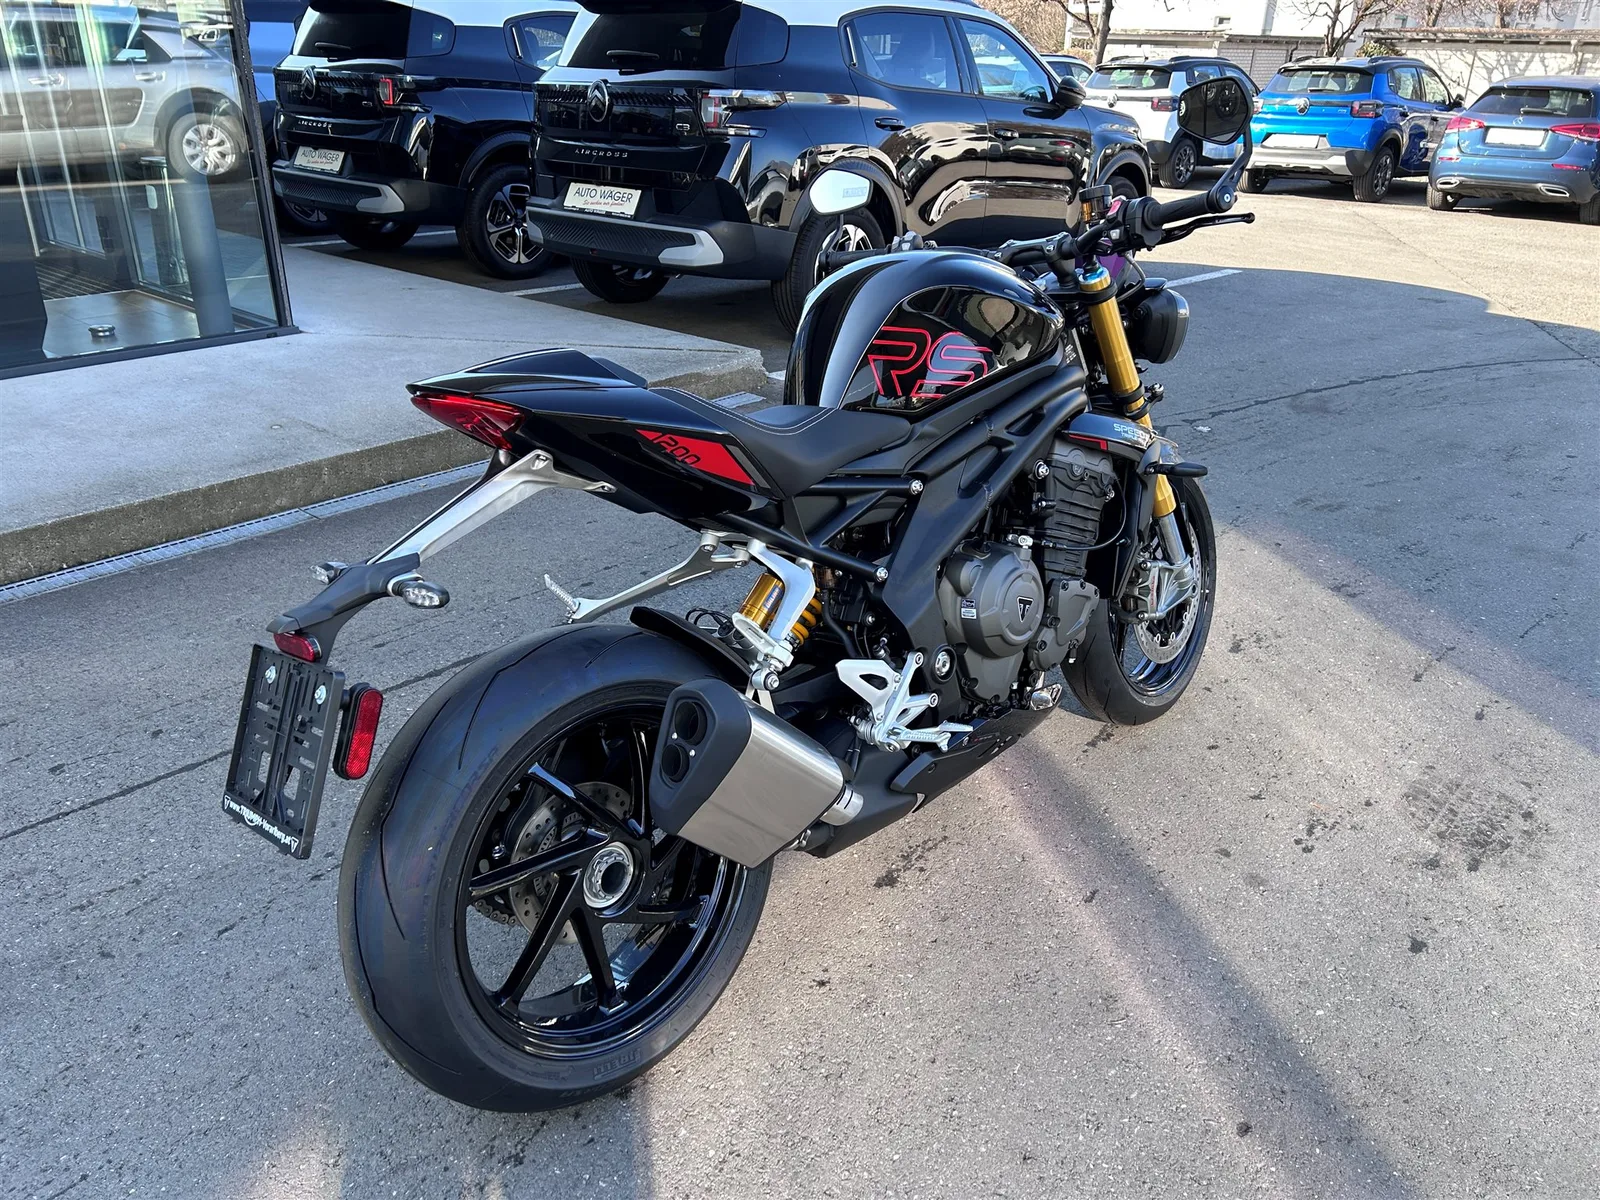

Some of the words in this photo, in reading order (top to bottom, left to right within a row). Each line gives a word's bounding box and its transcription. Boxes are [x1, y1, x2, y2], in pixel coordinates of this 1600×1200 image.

[301, 149, 317, 159] AUTO
[575, 148, 628, 158] AIRCROSS
[574, 187, 598, 199] AUTO
[600, 189, 633, 203] WÄGER
[867, 325, 993, 399] RS
[651, 433, 701, 466] 1200
